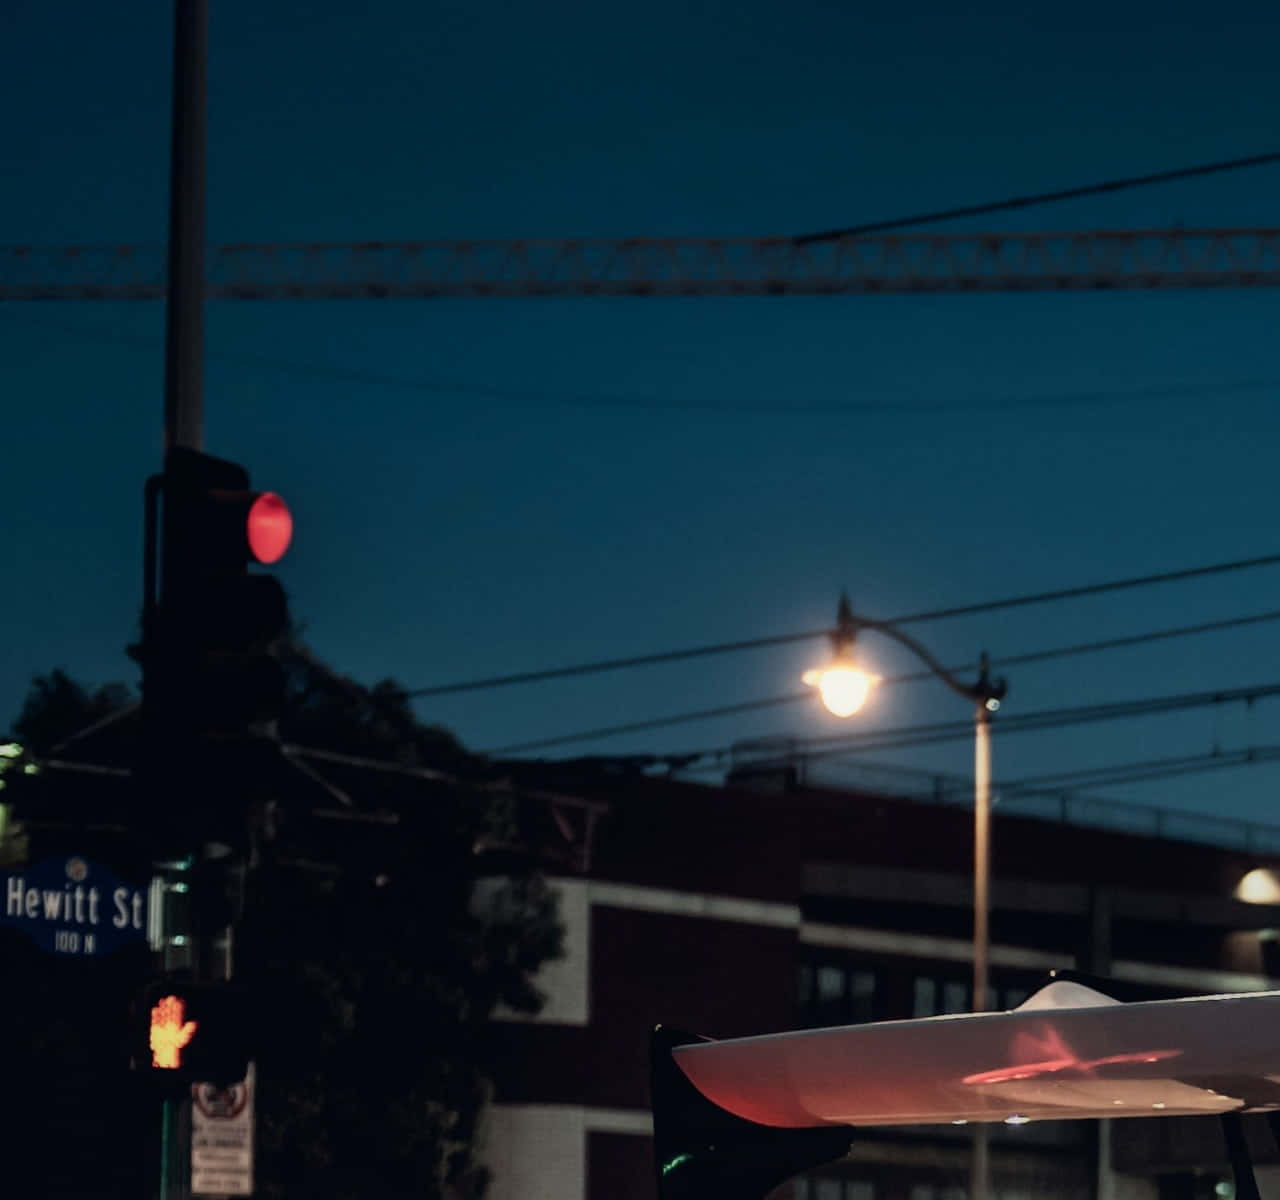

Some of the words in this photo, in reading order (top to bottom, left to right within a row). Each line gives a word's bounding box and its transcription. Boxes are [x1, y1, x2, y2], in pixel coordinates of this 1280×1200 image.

[6, 875, 100, 925] Hewitt
[112, 886, 144, 929] St
[55, 930, 79, 954] 100
[84, 932, 97, 955] N
